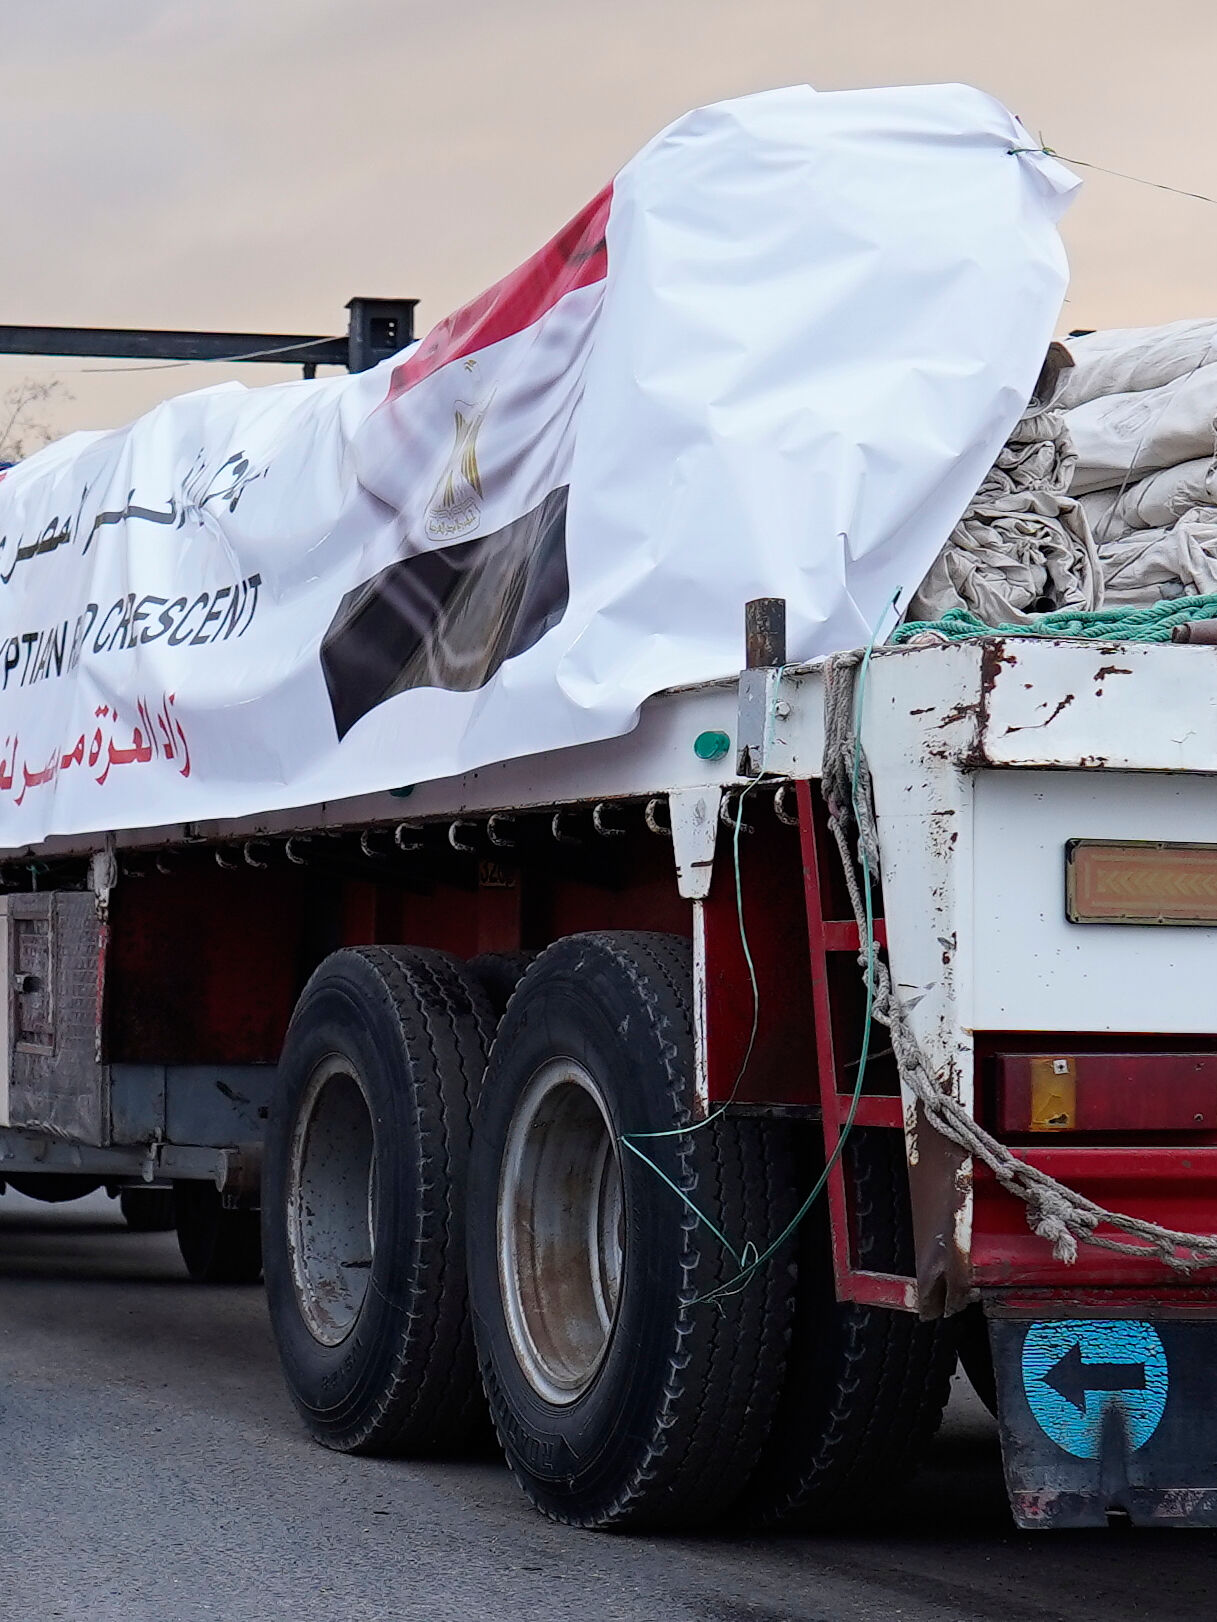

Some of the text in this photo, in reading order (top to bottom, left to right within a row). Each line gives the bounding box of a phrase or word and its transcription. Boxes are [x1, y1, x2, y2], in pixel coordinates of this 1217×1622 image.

[67, 603, 99, 674] RD
[92, 572, 262, 654] CRESCENT
[88, 694, 159, 786] العزة
[157, 690, 191, 778] زاد
